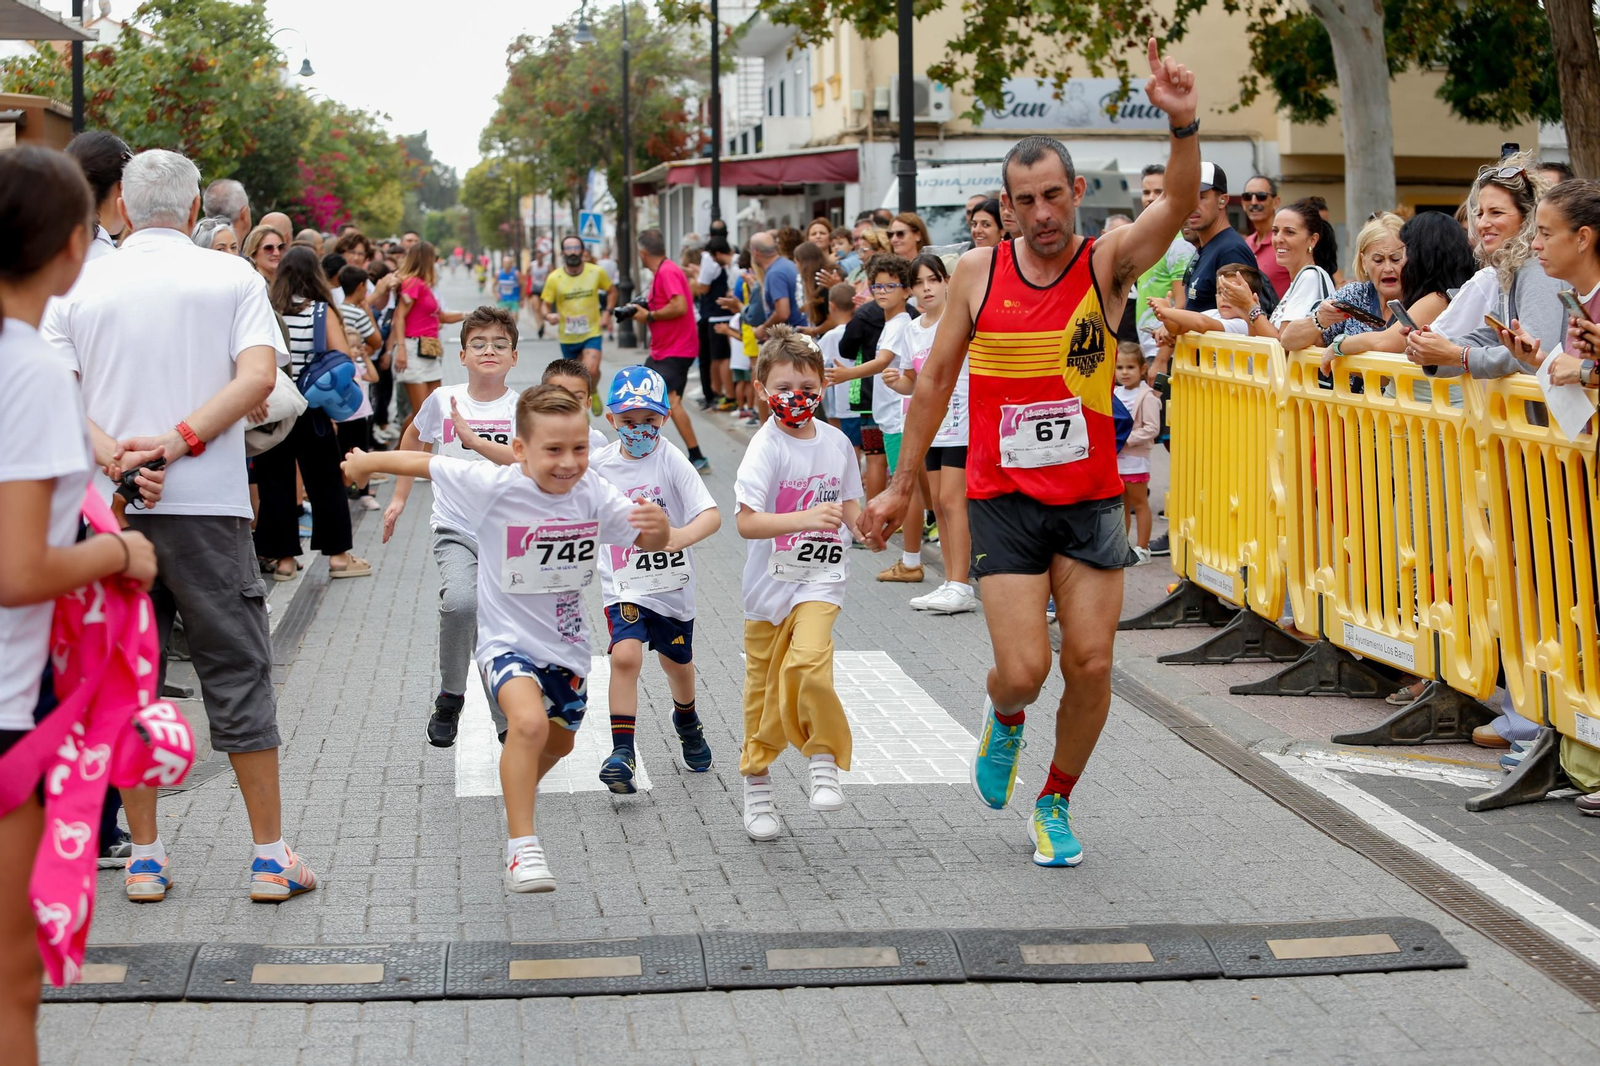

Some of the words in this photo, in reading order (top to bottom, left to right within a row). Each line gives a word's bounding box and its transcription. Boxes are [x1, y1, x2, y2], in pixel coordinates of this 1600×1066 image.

[989, 90, 1050, 119] Can
[1066, 352, 1105, 367] RUNNING
[1035, 419, 1071, 442] 67
[536, 540, 595, 565] 742
[635, 550, 686, 572] 492
[797, 543, 843, 564] 246
[1355, 634, 1384, 652] Ayuntamiento
[1384, 643, 1393, 656] Los
[1395, 647, 1414, 662] Barrios
